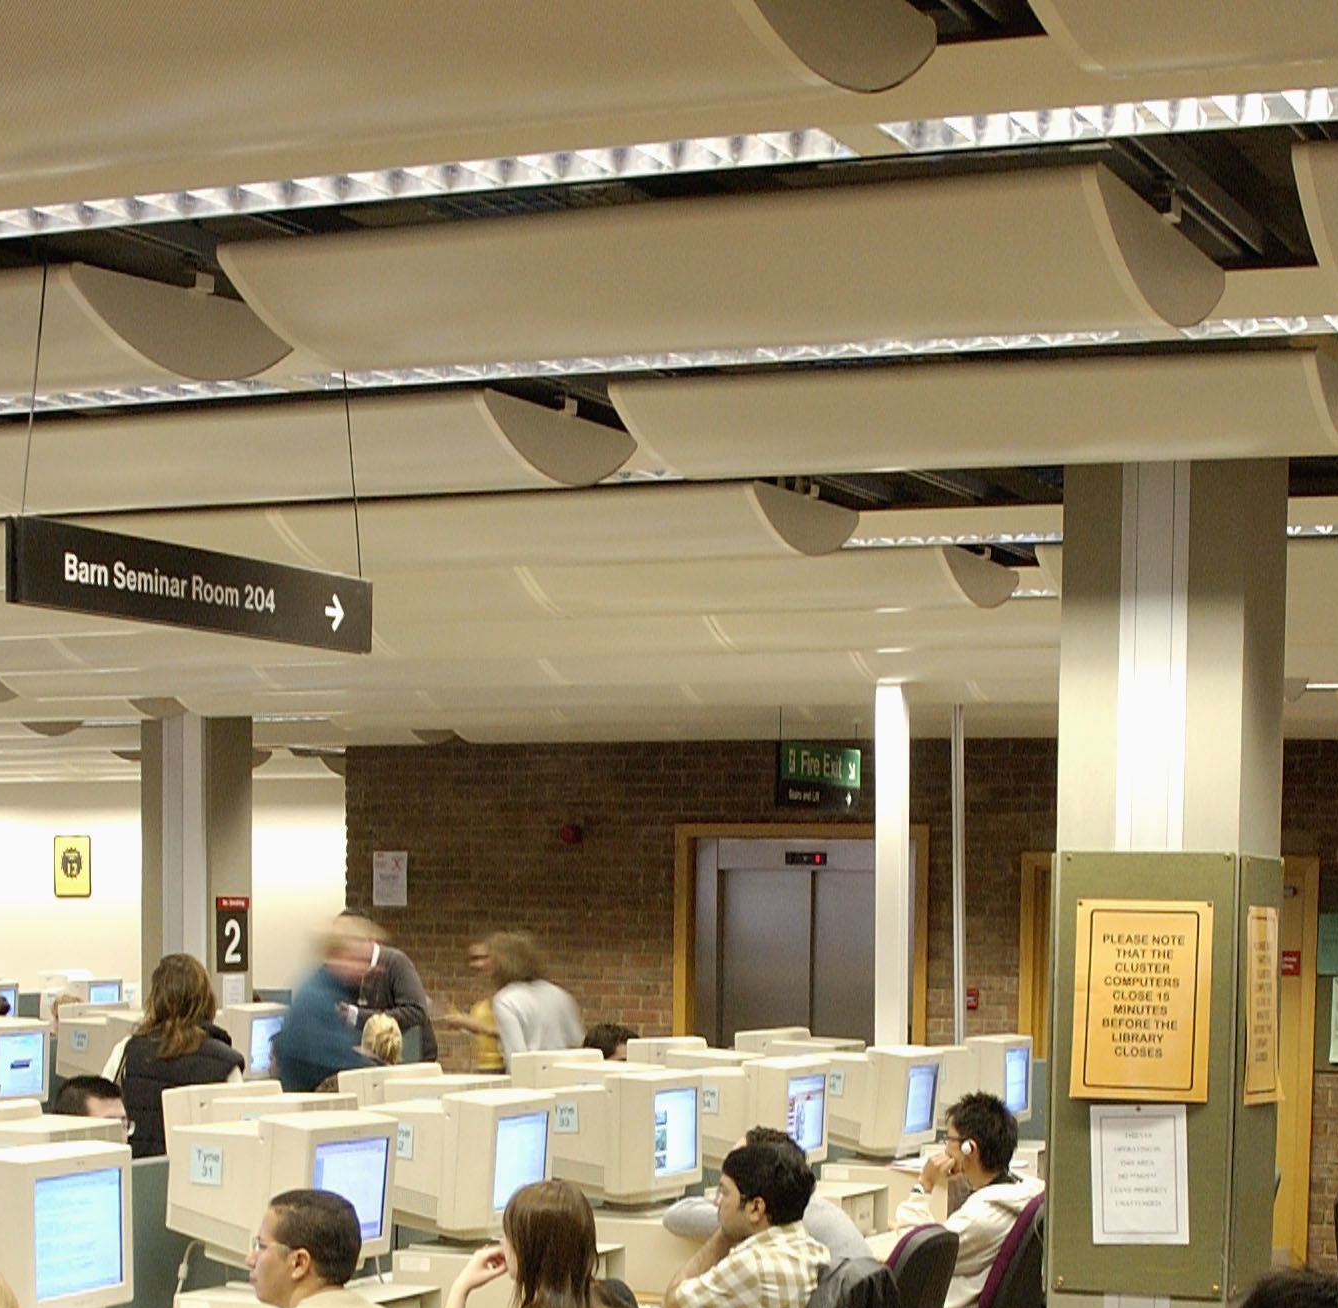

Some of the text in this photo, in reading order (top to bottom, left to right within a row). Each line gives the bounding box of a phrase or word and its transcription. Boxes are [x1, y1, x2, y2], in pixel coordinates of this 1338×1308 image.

[63, 551, 276, 614] Barn Seminar Room 204
[801, 750, 842, 779] Fire Exit
[224, 919, 241, 964] 2
[1103, 933, 1185, 946] PLEASE NOTE
[1116, 949, 1174, 960] THAT THE
[1115, 962, 1170, 973] CLUSTER
[1104, 976, 1180, 987] COMPUTERS
[1113, 990, 1170, 1002] CLOSE 15
[1113, 1005, 1167, 1016] MINUTES
[1102, 1018, 1178, 1030] BEFORE THE
[1111, 1033, 1164, 1044] LIBRARY
[1114, 1046, 1163, 1058] CLOSES
[398, 1129, 411, 1138] ne
[195, 1149, 220, 1165] Tyne
[201, 1165, 213, 1178] 31
